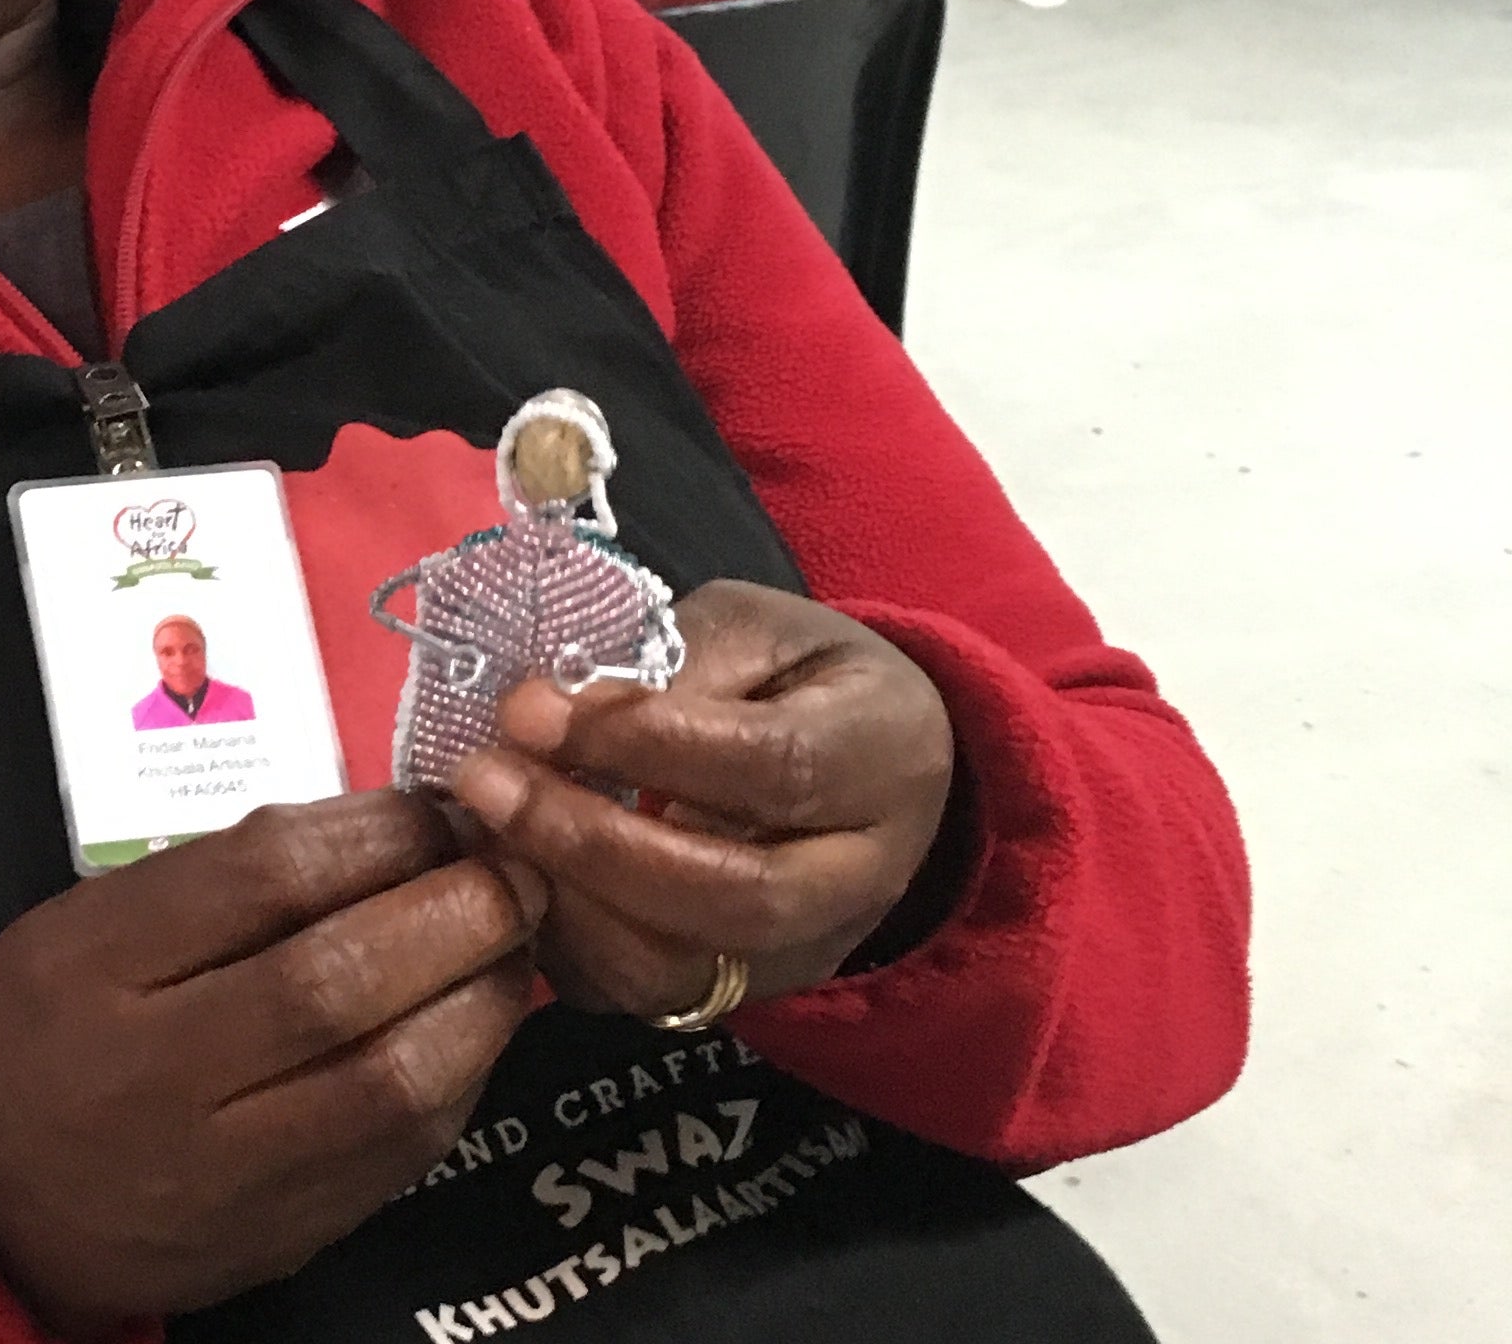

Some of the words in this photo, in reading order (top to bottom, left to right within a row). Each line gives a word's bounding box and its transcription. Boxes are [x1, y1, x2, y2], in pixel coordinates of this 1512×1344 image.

[129, 502, 187, 532] Heart
[130, 538, 188, 559] Africa
[391, 1116, 529, 1202] AND
